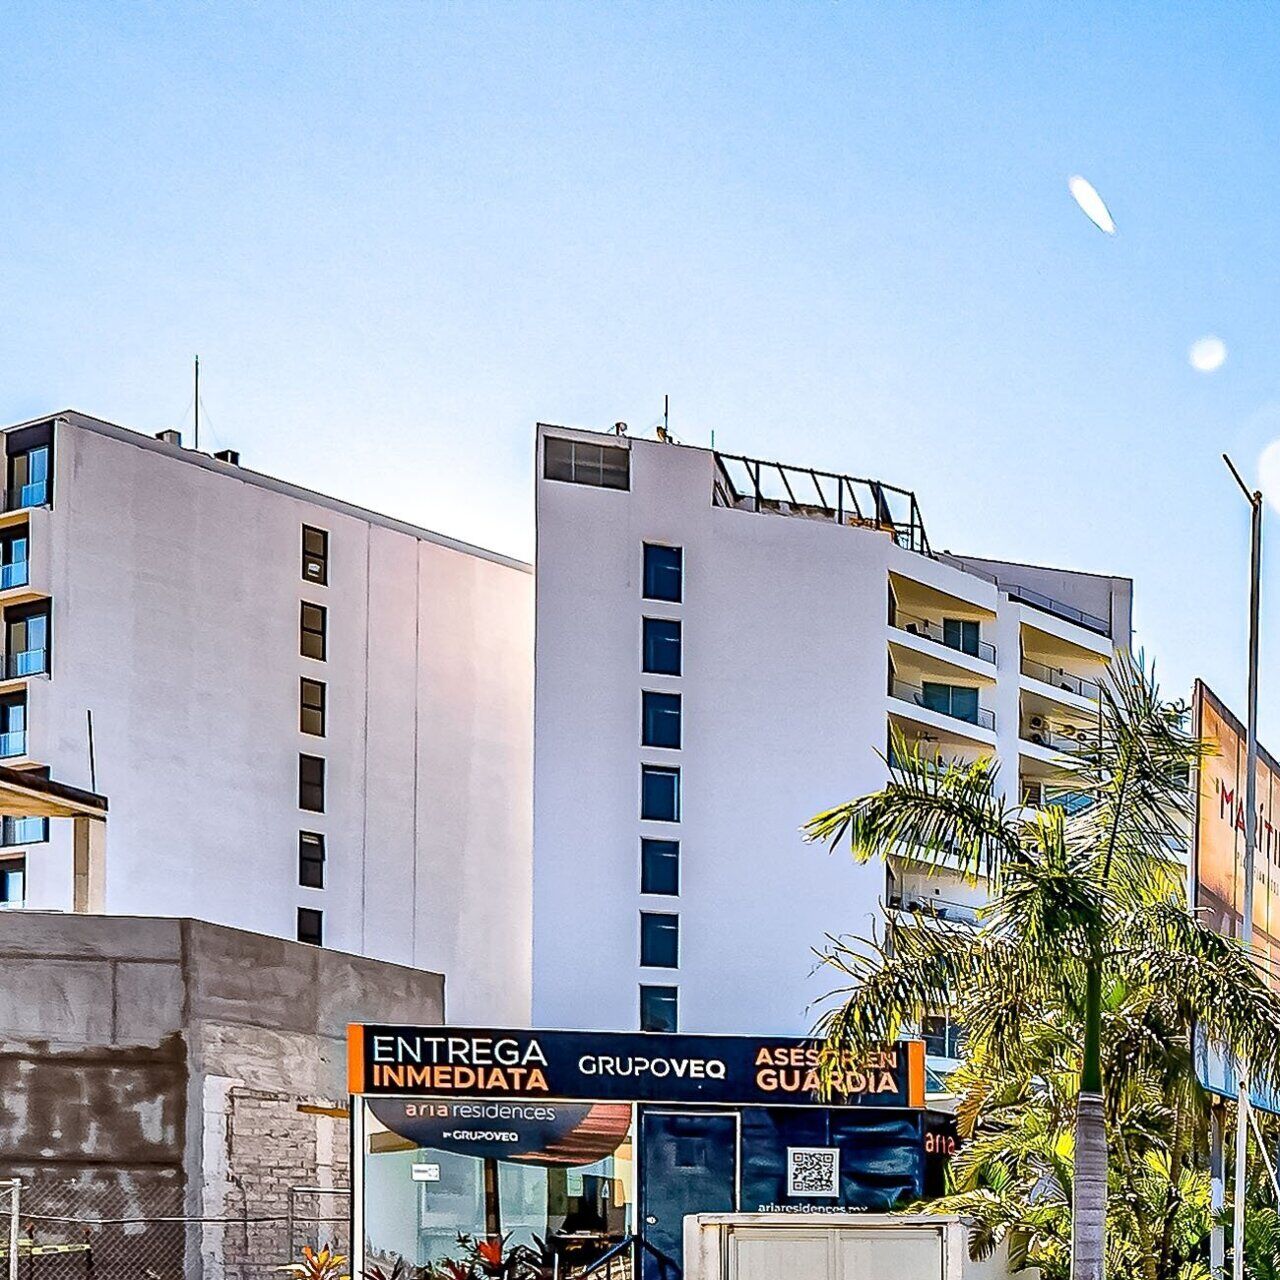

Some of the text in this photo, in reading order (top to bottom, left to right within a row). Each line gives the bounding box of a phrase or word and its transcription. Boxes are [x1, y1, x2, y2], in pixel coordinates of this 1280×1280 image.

[373, 1035, 549, 1067] ENTREGA
[863, 1050, 898, 1069] EN
[373, 1064, 549, 1091] INMEDIATA
[578, 1054, 726, 1080] GRUPOVEQ
[405, 1103, 556, 1121] aria residences
[452, 1130, 519, 1142] GRUPOVEQ
[925, 1132, 956, 1155] aria
[757, 1202, 868, 1214] ariaresidencesmx
